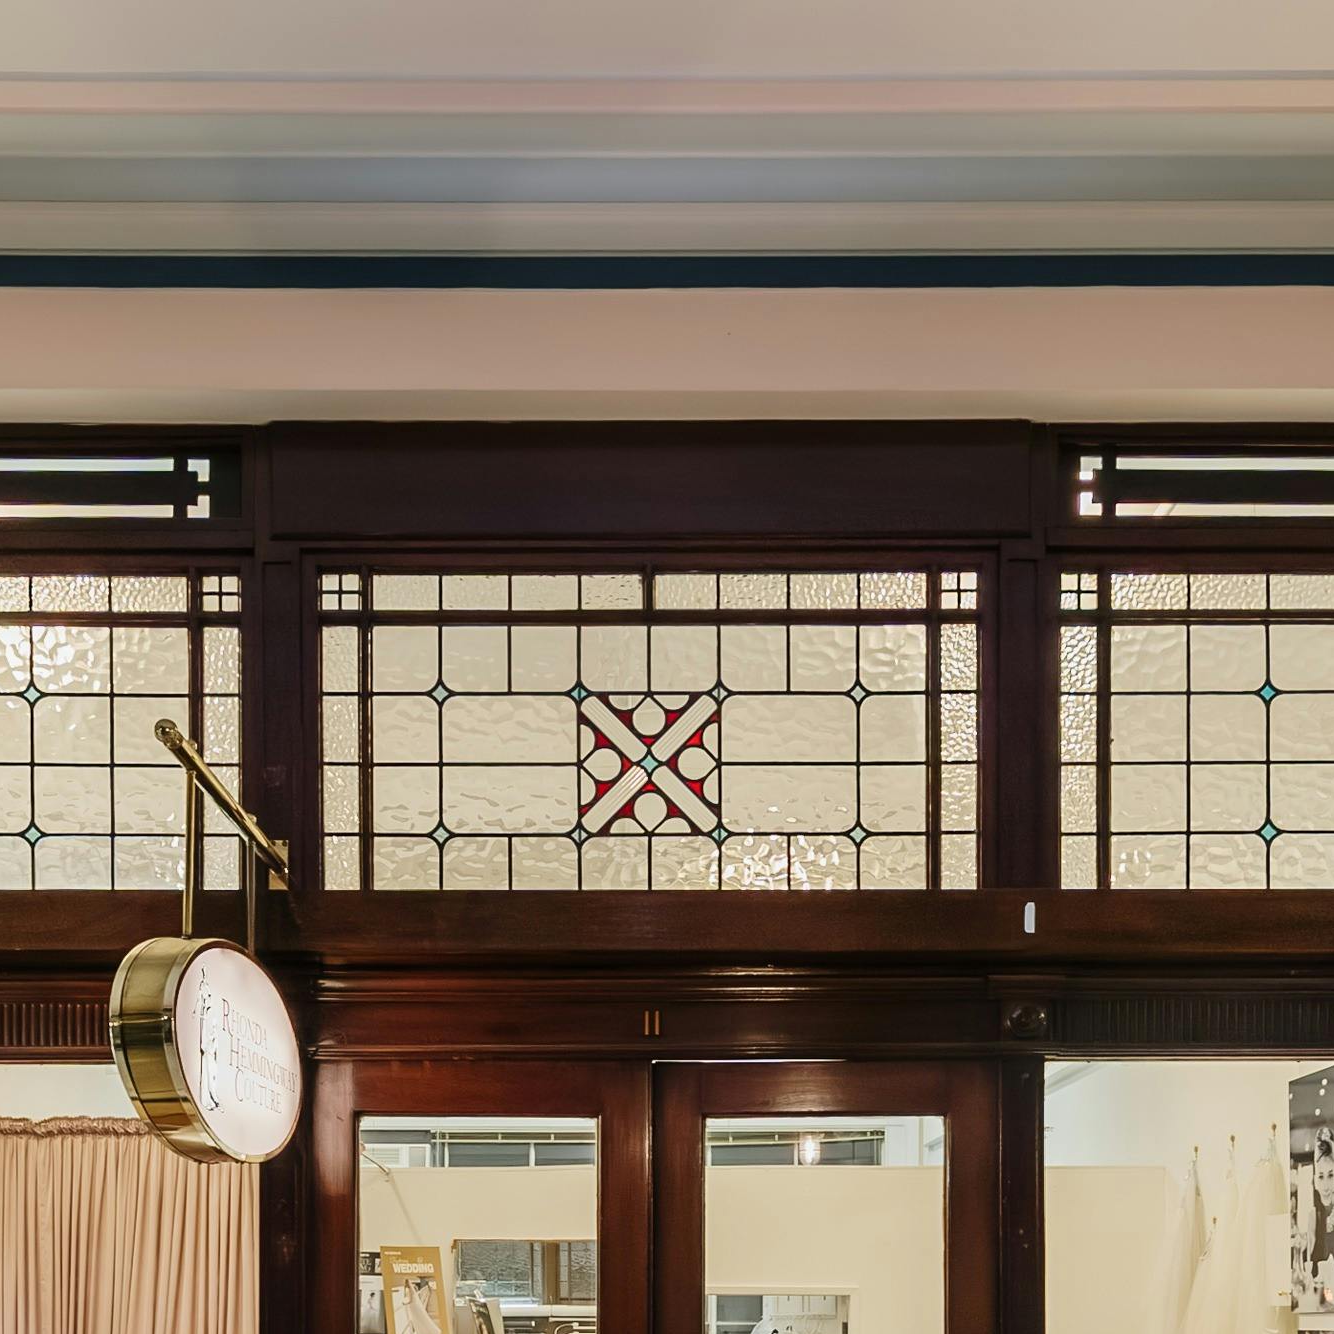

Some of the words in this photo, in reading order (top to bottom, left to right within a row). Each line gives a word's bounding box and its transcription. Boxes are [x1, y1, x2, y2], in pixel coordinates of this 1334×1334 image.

[221, 998, 268, 1051] RHONDA
[229, 1037, 298, 1094] HEMMINGWAY
[234, 1069, 282, 1114] COUTURE
[393, 1263, 434, 1273] WEDDING
